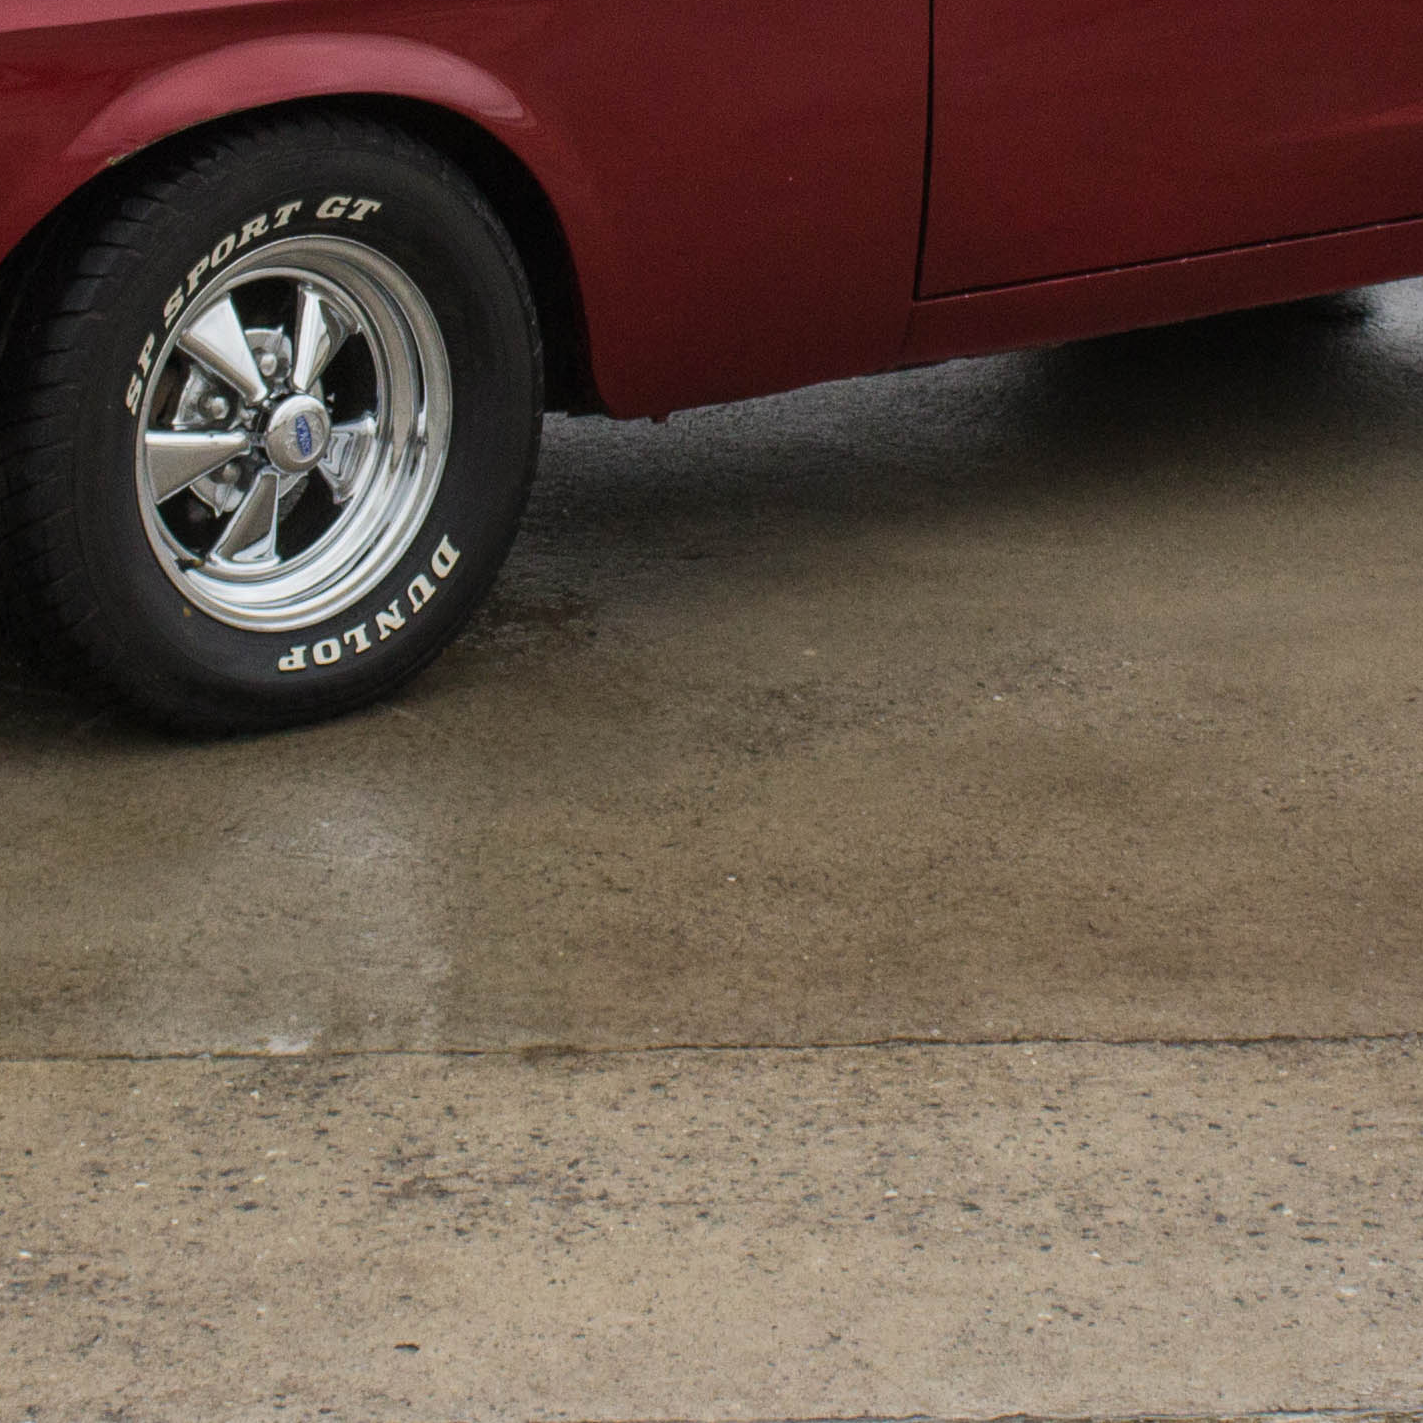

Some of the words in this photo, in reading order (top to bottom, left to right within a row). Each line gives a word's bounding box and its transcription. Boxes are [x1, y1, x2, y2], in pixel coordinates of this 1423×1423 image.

[125, 332, 158, 417] SP
[163, 200, 304, 328] SPORT
[317, 195, 383, 222] GT
[278, 534, 461, 673] DUNLOP
